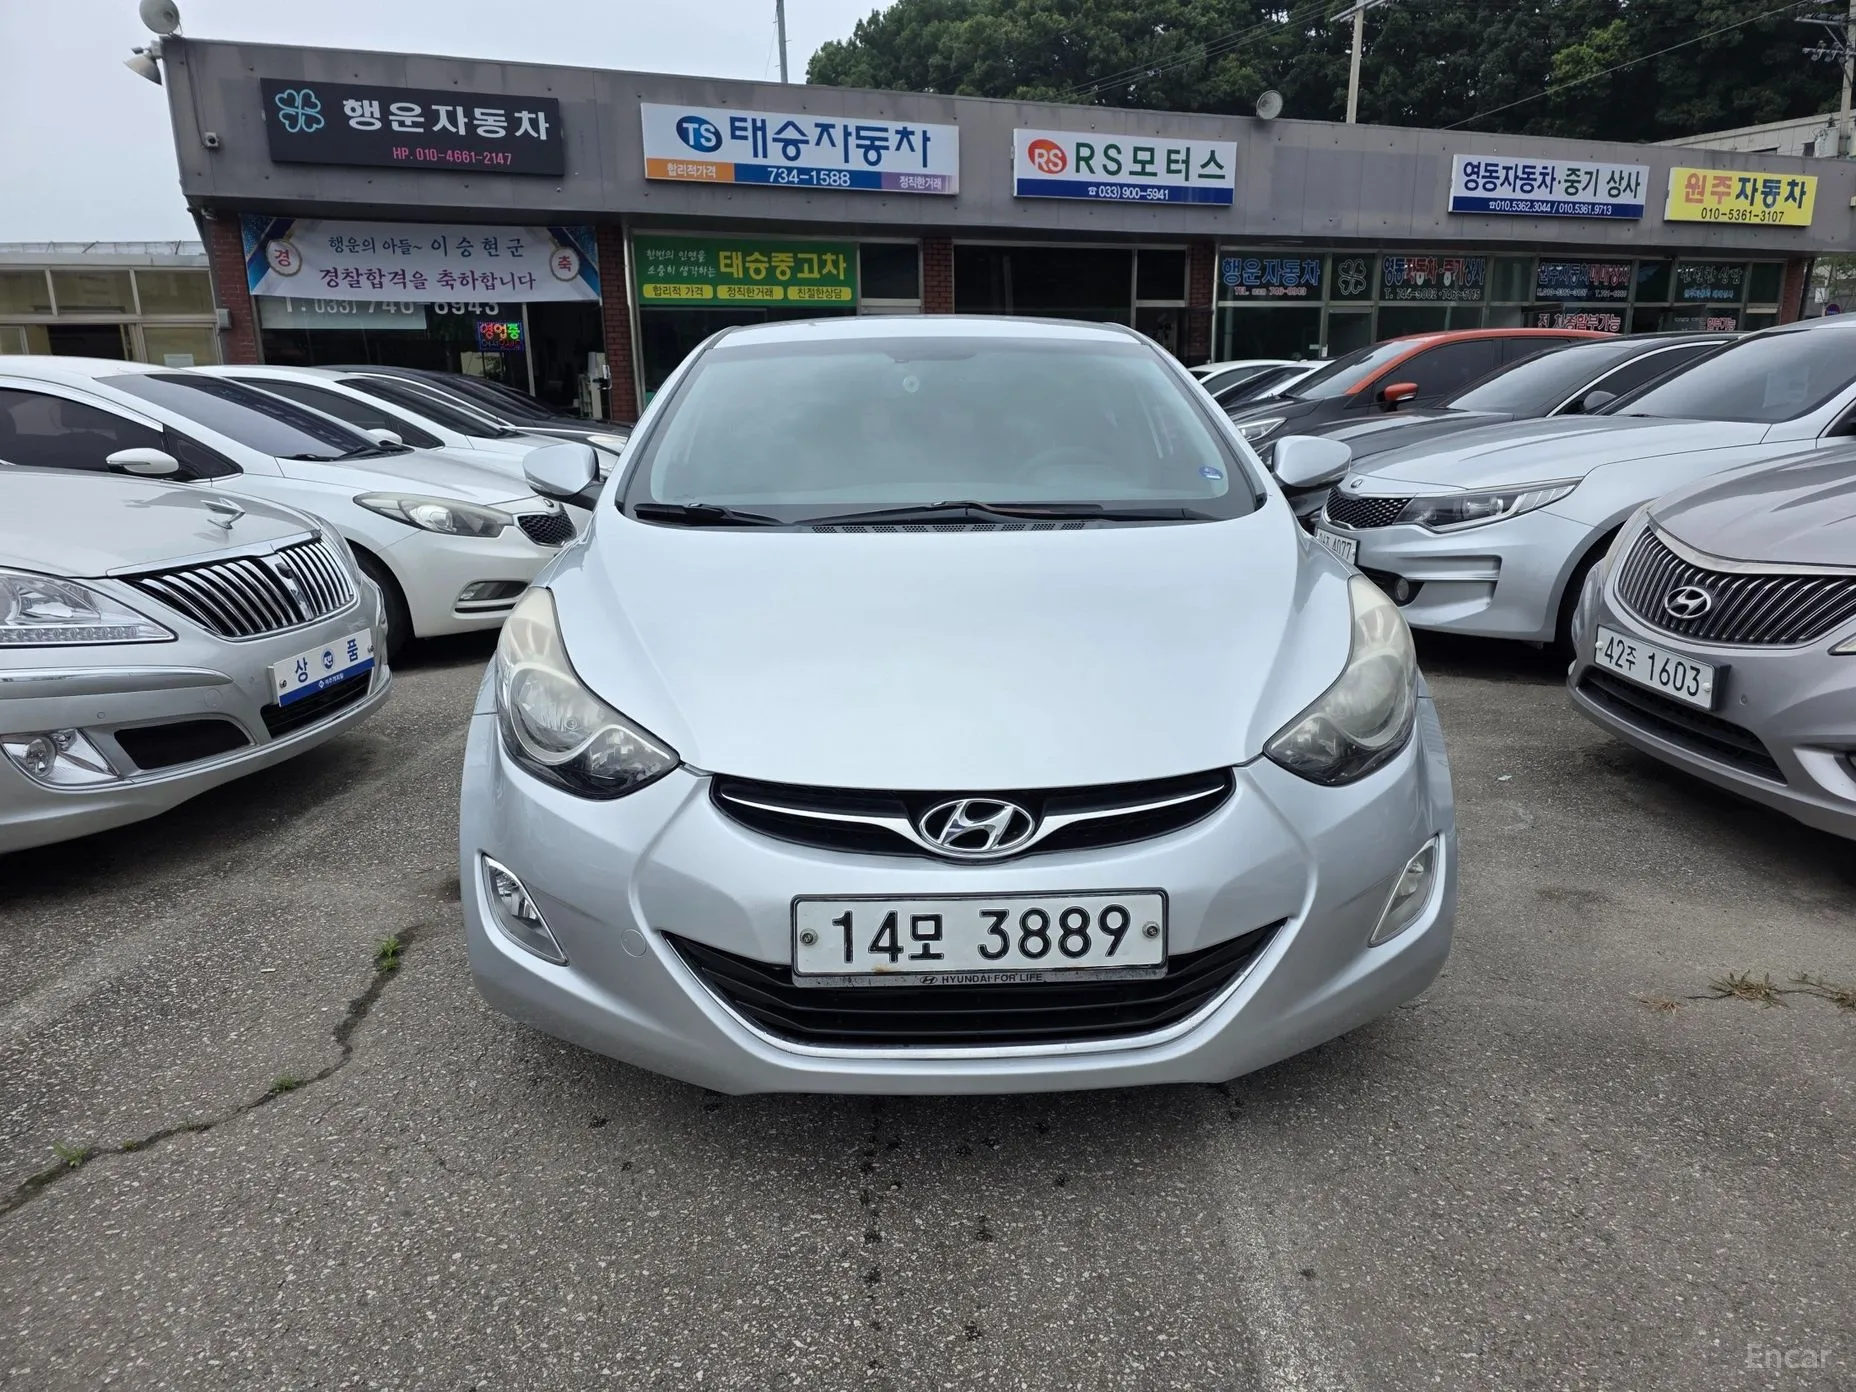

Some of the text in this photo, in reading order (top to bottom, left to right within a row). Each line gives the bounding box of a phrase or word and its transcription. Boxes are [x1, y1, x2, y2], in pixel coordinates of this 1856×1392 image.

[342, 98, 550, 141] 행운자동차
[682, 122, 718, 147] TS
[729, 115, 931, 169] 태승자동차
[416, 148, 513, 166] 010-4661-2147
[1034, 148, 1063, 172] RS
[1075, 141, 1227, 182] RS모터스
[666, 162, 717, 179] 합리적가격
[767, 167, 851, 187] 734-1588
[899, 175, 942, 191] 정직한거래
[1684, 172, 1807, 209] 원주자동차
[1122, 187, 1169, 200] 900-5941
[1701, 207, 1785, 223] 010-5361-3107
[328, 236, 376, 254] 행운의
[274, 249, 292, 267] 경
[557, 255, 573, 272] 축
[719, 250, 846, 281] 태승중고차
[319, 266, 536, 291] 경찰합격을 축하합니다
[679, 265, 717, 278] 생각하는
[1222, 258, 1321, 286] 행운자동차
[652, 285, 705, 298] 합리적 가격
[726, 287, 774, 299] 정직한거래
[796, 288, 842, 299] 친절한상담
[295, 657, 308, 683] 상
[347, 638, 358, 662] 품
[1604, 636, 1701, 697] 42주 1603
[832, 903, 1132, 964] 14모 3889
[942, 975, 991, 984] HYUNDAI
[1020, 973, 1041, 982] LIFE
